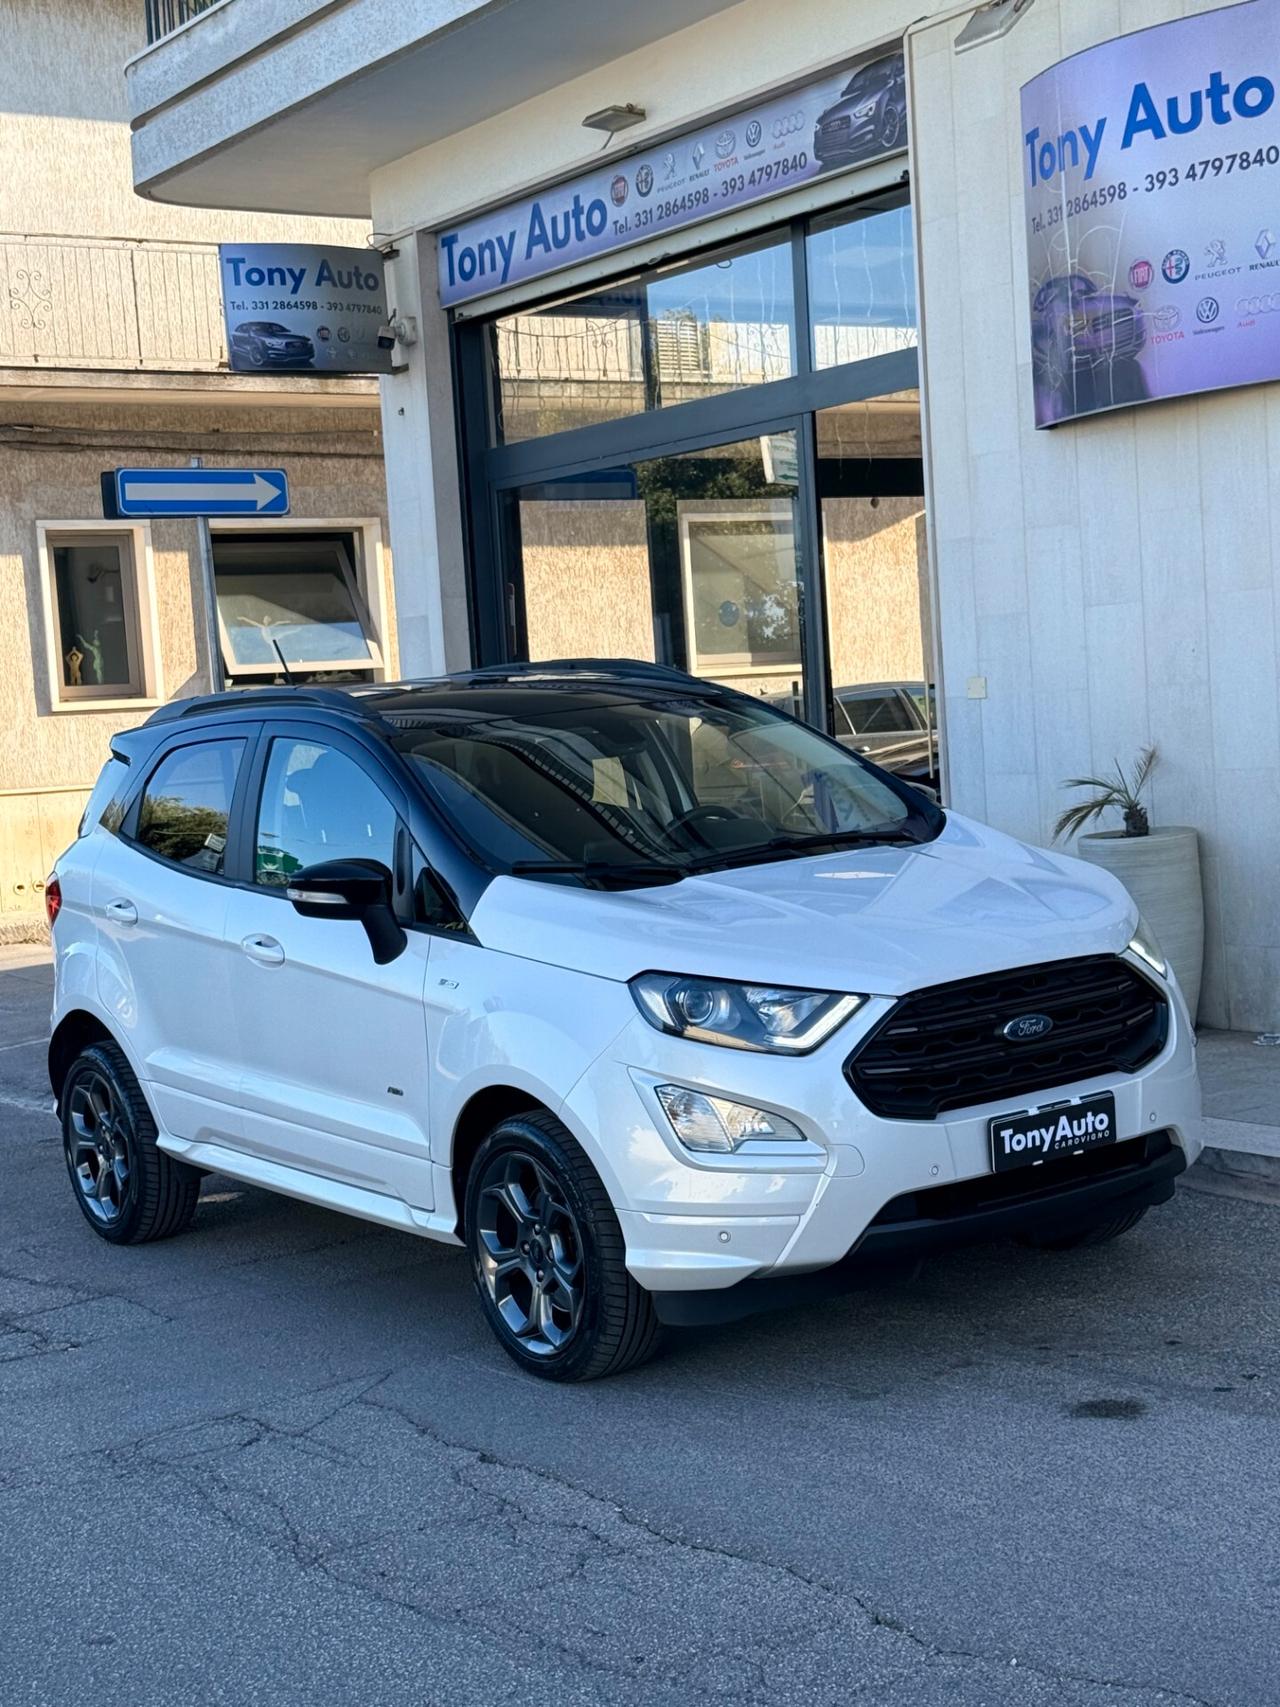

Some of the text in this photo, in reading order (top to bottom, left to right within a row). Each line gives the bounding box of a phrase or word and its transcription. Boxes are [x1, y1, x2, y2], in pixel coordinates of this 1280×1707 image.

[1026, 71, 1275, 188] Tony Auto
[713, 156, 739, 172] TOYOTA
[612, 216, 632, 236] Tel.
[634, 207, 653, 229] 331
[656, 187, 710, 221] 2864598
[721, 175, 745, 197] 393
[748, 152, 807, 186] 4797840
[1032, 213, 1046, 234] Tel.
[1047, 204, 1063, 227] 331
[1066, 182, 1127, 218] 2864598
[1144, 168, 1179, 193] 393
[1185, 145, 1280, 182] 4797840
[440, 194, 608, 287] Tony Auto
[226, 257, 379, 295] Tony Auto
[1195, 260, 1280, 281] PEUGEOT RENAUL
[231, 301, 248, 311] Tel.
[252, 301, 269, 310] 331
[272, 300, 318, 311] 2864598
[1150, 331, 1185, 345] TOYOTA
[1018, 1018, 1044, 1036] Ford
[1054, 1130, 1110, 1150] CAROVIGNO
